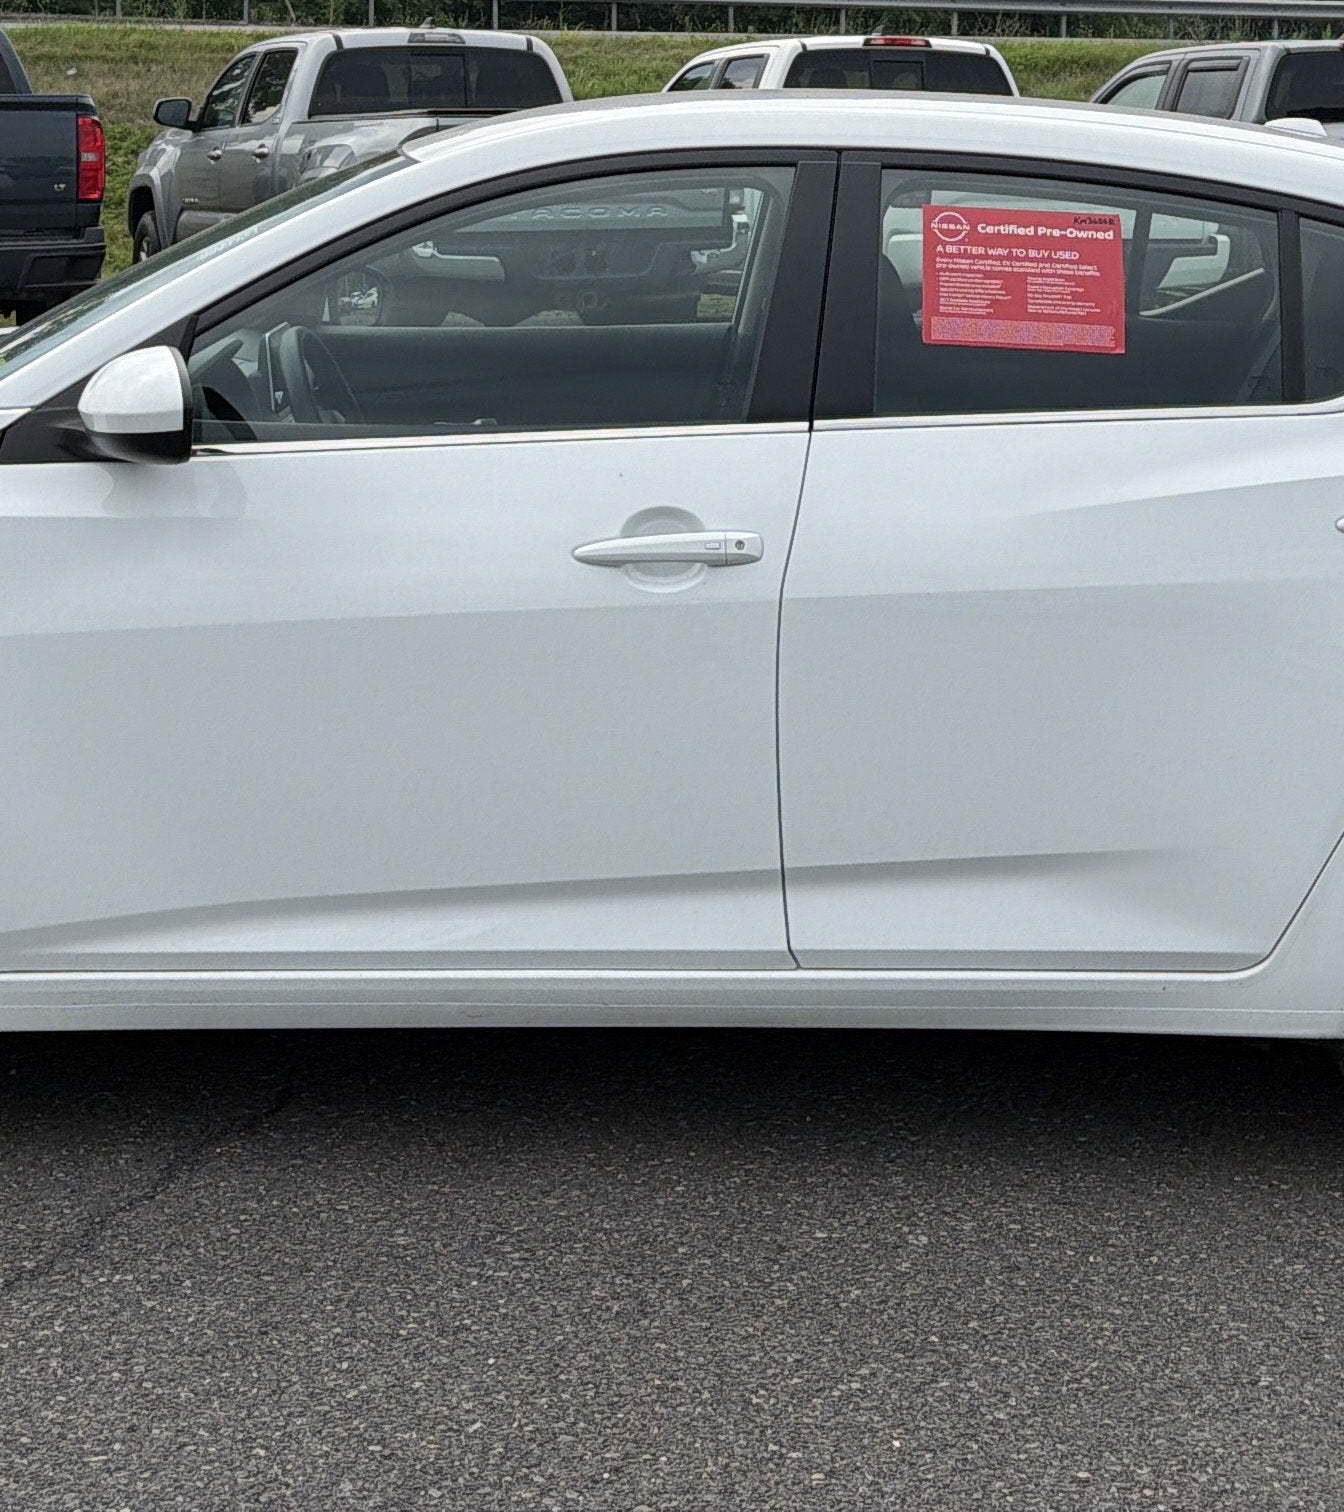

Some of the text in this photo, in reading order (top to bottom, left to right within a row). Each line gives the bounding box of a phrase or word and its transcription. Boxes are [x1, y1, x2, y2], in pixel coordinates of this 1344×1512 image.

[512, 203, 668, 220] ACOMA
[930, 222, 971, 231] NISSAN
[977, 223, 1114, 240] Certified Pre-Owned
[936, 244, 1080, 260] A BETTER WAY TO BUY USED
